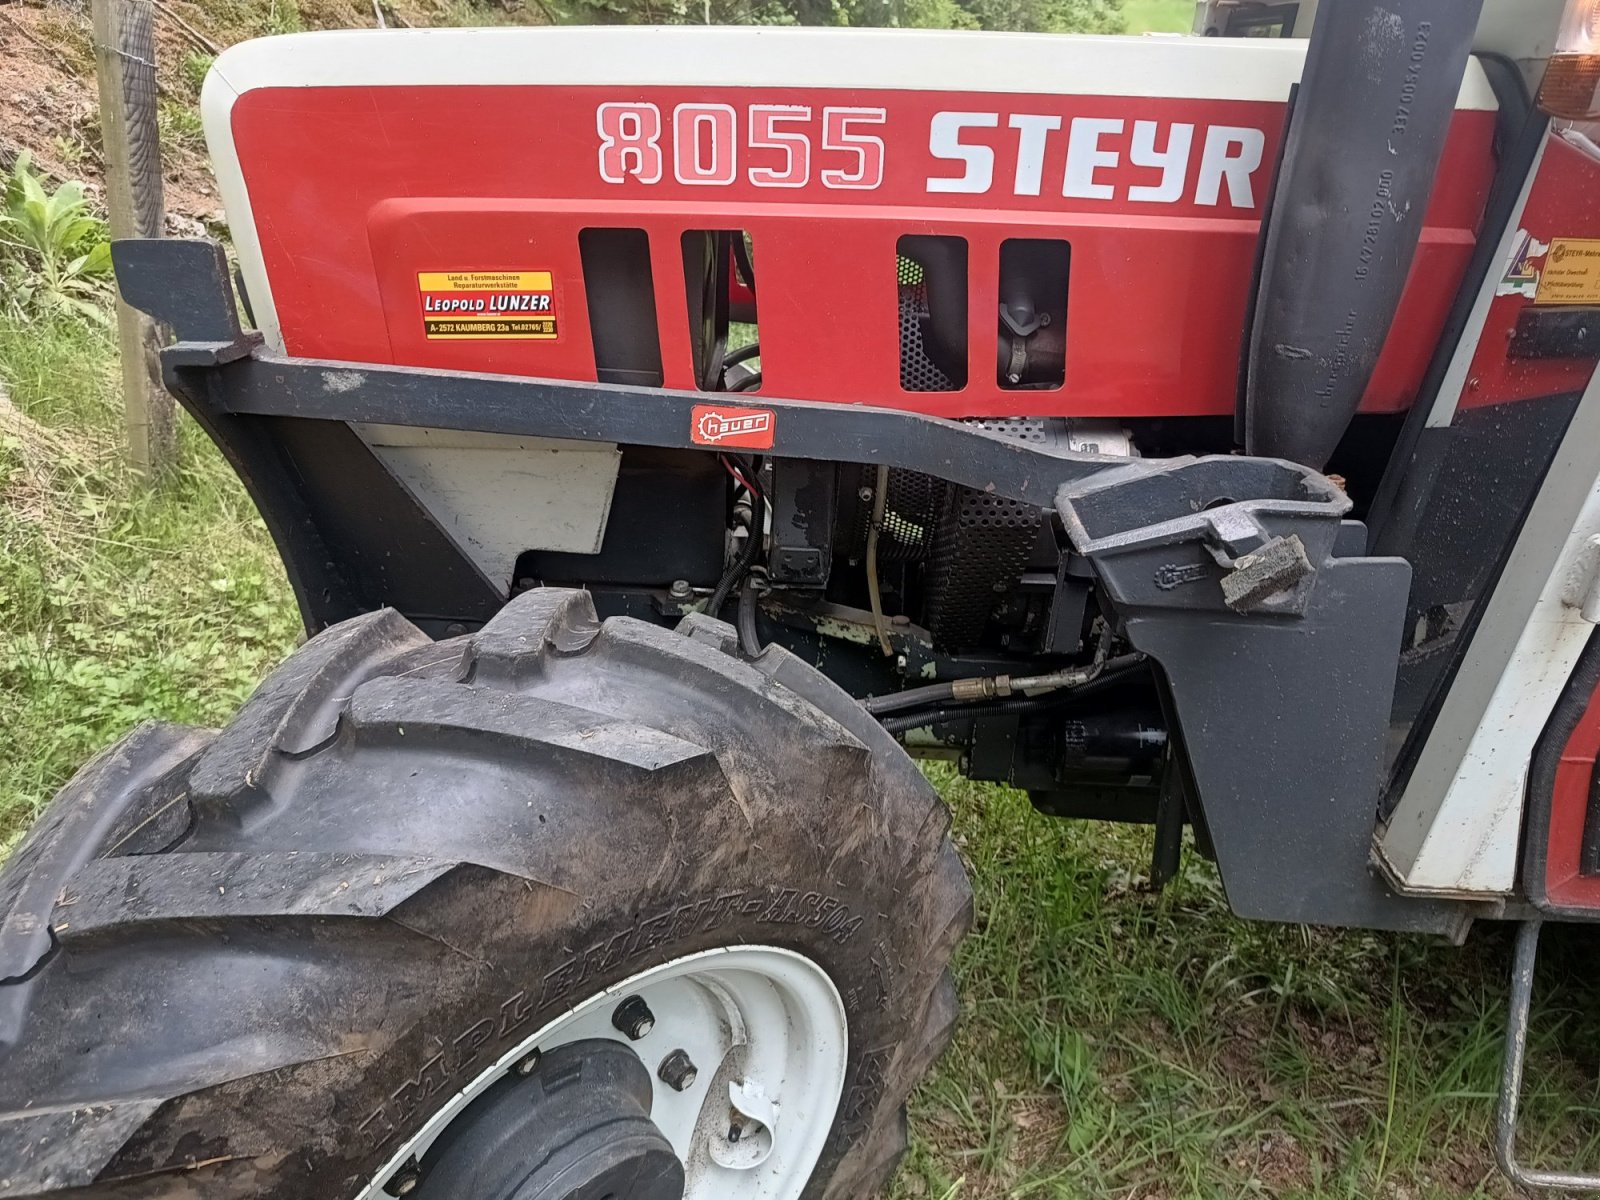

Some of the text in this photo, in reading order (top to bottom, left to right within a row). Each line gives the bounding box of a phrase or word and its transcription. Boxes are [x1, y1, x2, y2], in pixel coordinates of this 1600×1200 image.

[596, 101, 1266, 208] 8055 STEYR
[453, 281, 518, 289] Reparaturwerkstätte
[425, 295, 550, 311] LEOPOLD LUNZER
[455, 323, 496, 332] KAUMBERG
[707, 418, 765, 434] hauer
